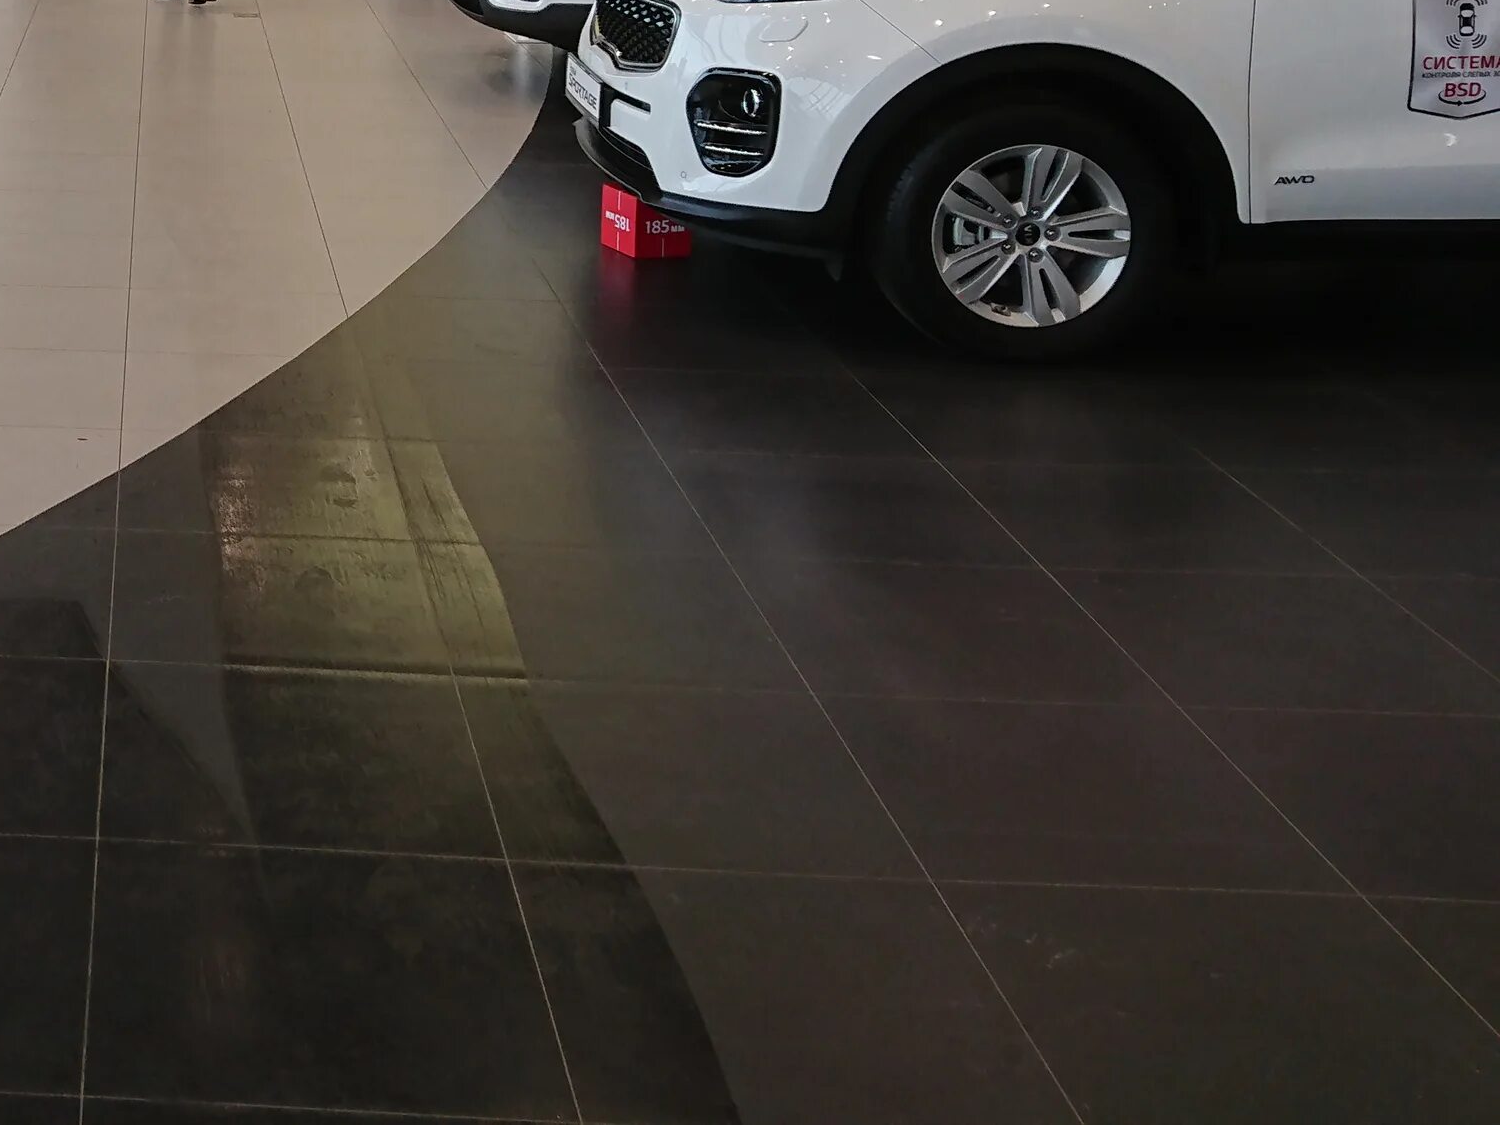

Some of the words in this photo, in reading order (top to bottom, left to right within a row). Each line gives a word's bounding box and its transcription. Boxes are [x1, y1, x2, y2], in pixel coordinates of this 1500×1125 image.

[568, 73, 598, 110] SPORTAGE
[1444, 82, 1482, 97] BSD
[1273, 175, 1316, 186] AWD
[614, 214, 630, 232] 185
[645, 219, 670, 234] 185
